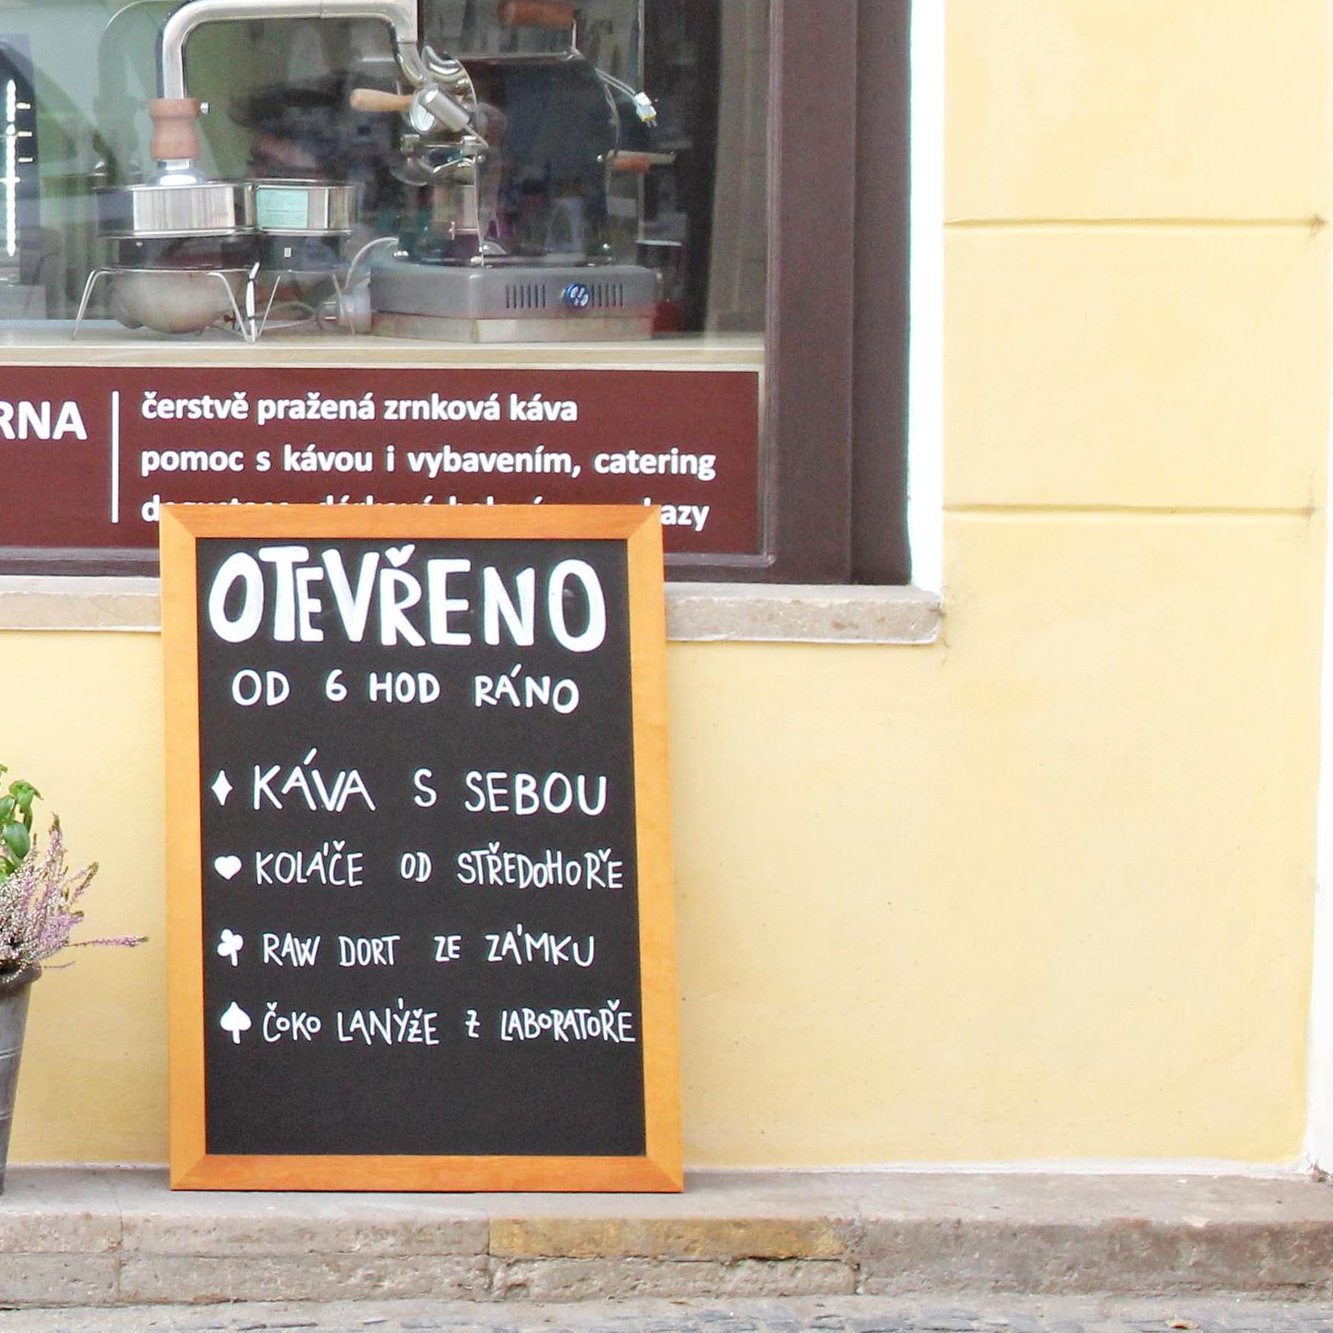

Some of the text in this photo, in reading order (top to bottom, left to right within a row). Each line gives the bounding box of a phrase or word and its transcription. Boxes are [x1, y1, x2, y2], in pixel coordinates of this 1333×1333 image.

[141, 391, 578, 426] čerstvě pražená zrnková káva
[141, 443, 716, 481] pomoc s kávou i vybavením, catering
[208, 543, 607, 653] OTEVŘENO
[231, 663, 580, 714] OD 6 HOD RÁNO
[253, 747, 607, 816] KÁVA S SEBOU
[255, 840, 623, 890] KOLÁČE OD STŘEDOHOŘE
[262, 923, 595, 967] RAW DORT ZE ZÁMKU
[337, 997, 440, 1046] LANÝŽE
[500, 999, 636, 1043] LABORATOŘE
